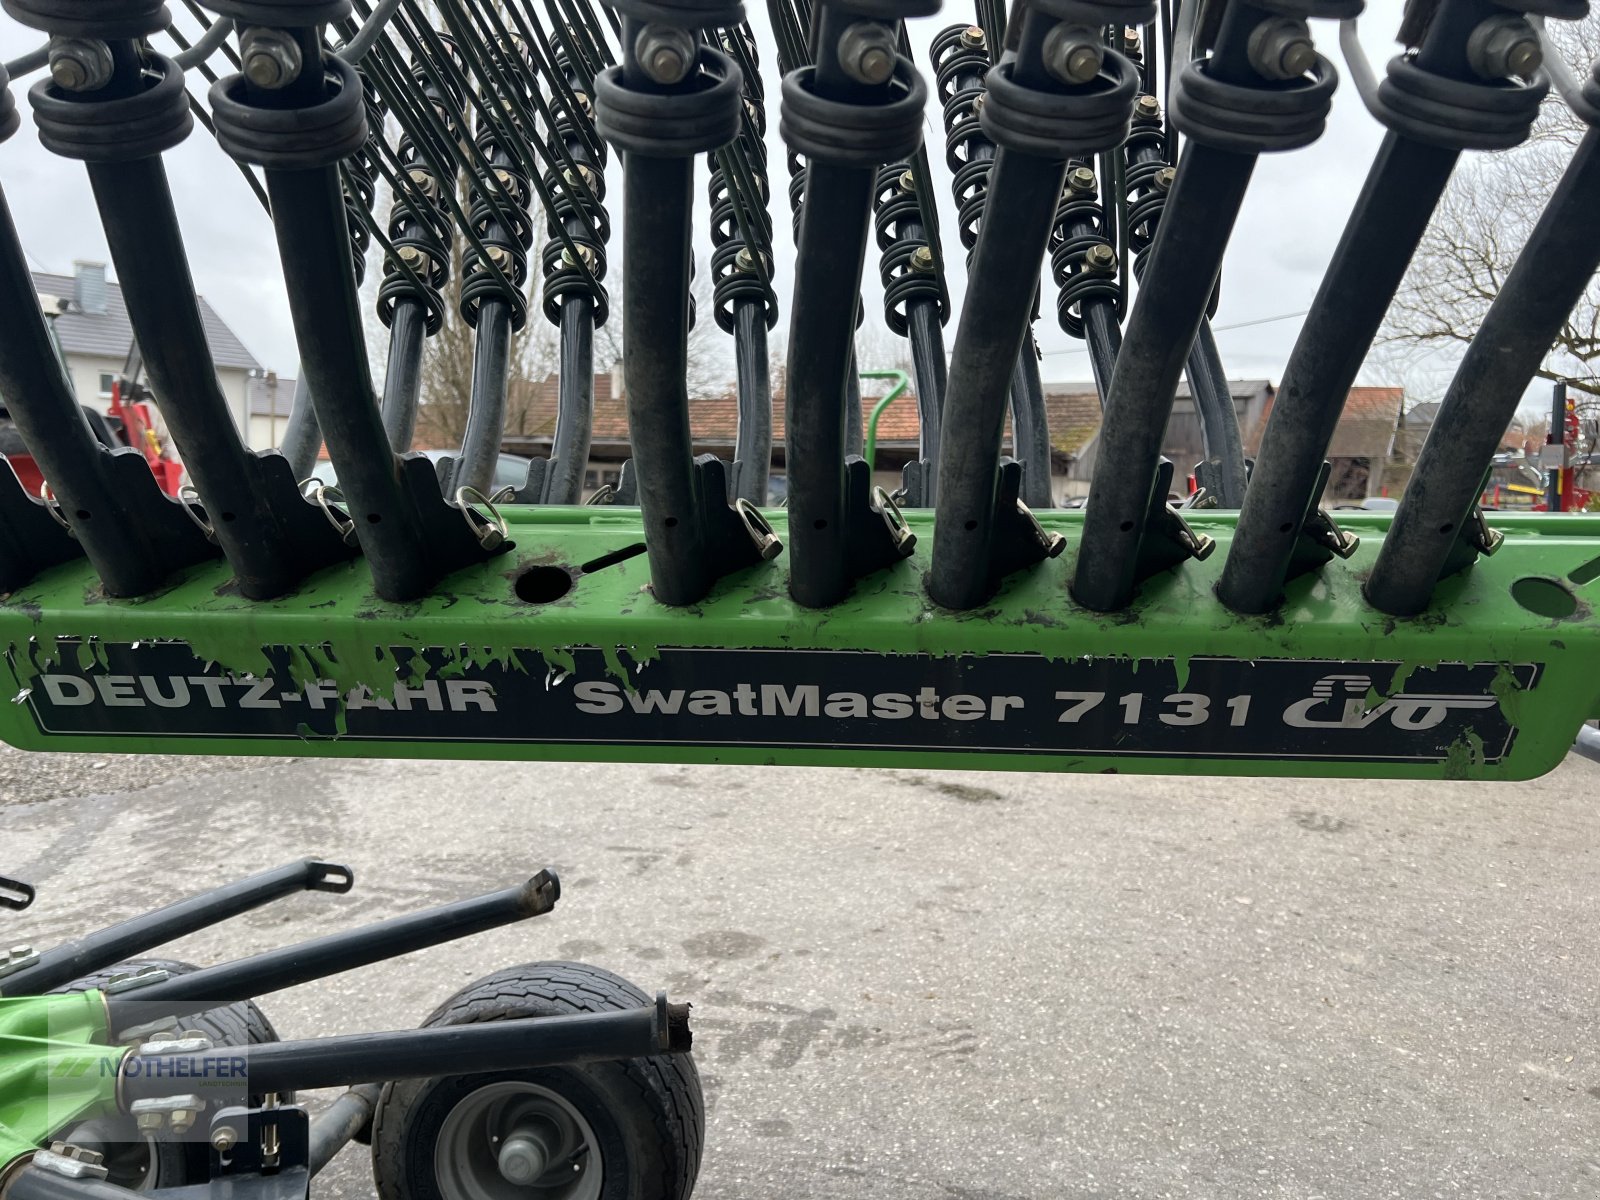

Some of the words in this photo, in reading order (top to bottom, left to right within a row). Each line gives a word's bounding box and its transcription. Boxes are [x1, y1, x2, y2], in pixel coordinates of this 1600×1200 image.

[39, 674, 498, 712] DEUTZ-FAHR
[572, 681, 1025, 721] SwatMaster
[1055, 691, 1252, 727] 7131
